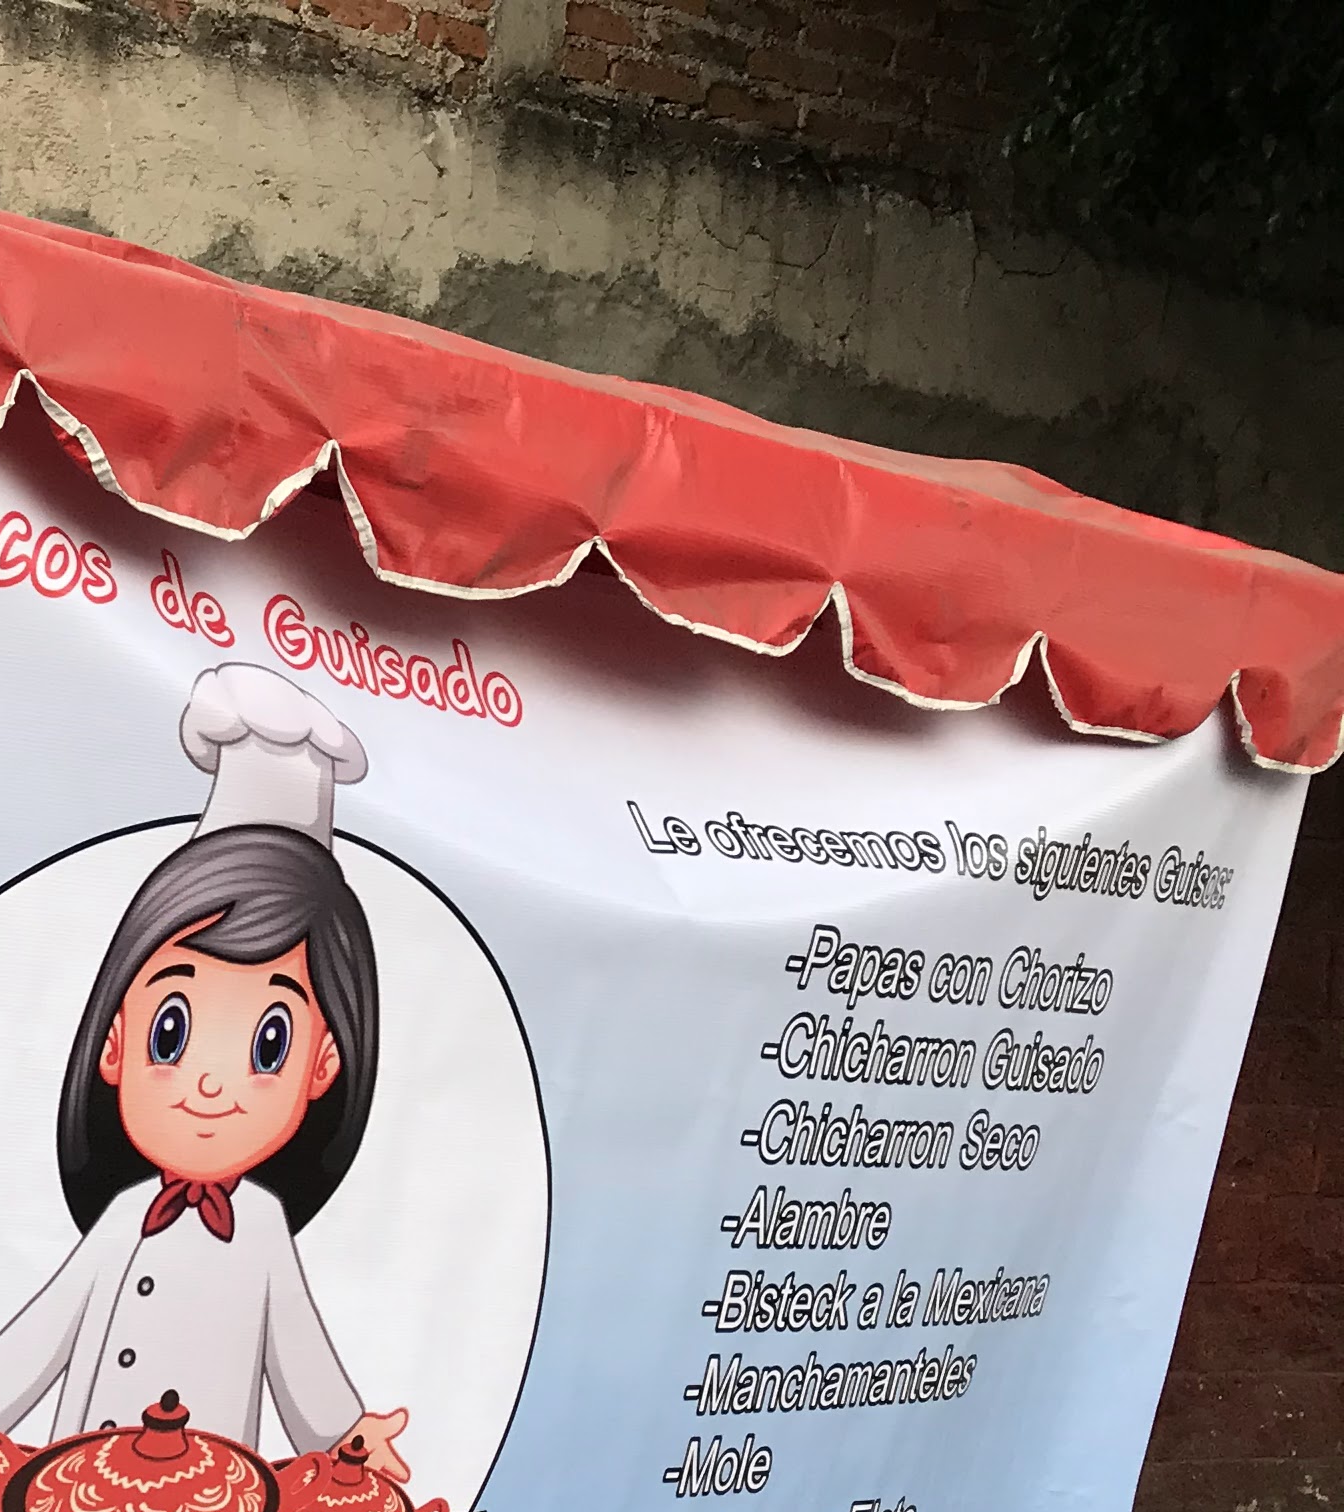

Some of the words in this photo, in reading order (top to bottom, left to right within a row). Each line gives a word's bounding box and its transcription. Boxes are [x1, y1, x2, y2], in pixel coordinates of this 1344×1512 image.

[150, 549, 236, 648] de
[263, 595, 524, 728] Guisado
[627, 801, 702, 856] Le
[705, 812, 946, 877] ofrecemos
[945, 820, 1008, 881] los
[1015, 826, 1151, 900] siguientes
[785, 924, 923, 1011] -Papas
[928, 952, 993, 1007] con
[998, 947, 1113, 1017] Chorizo
[761, 1013, 976, 1090] -Chicharron
[982, 1024, 1105, 1095] Guisado
[741, 1098, 956, 1170] -Chicharron
[959, 1109, 1040, 1171] Seco
[721, 1186, 891, 1249] -Alambre
[701, 1269, 855, 1333] -Bisteck
[857, 1289, 883, 1331] a
[886, 1270, 920, 1329] la
[923, 1269, 1050, 1325] Mexicana
[684, 1345, 978, 1416] -Manchamanteles
[663, 1434, 773, 1498] -Mole
